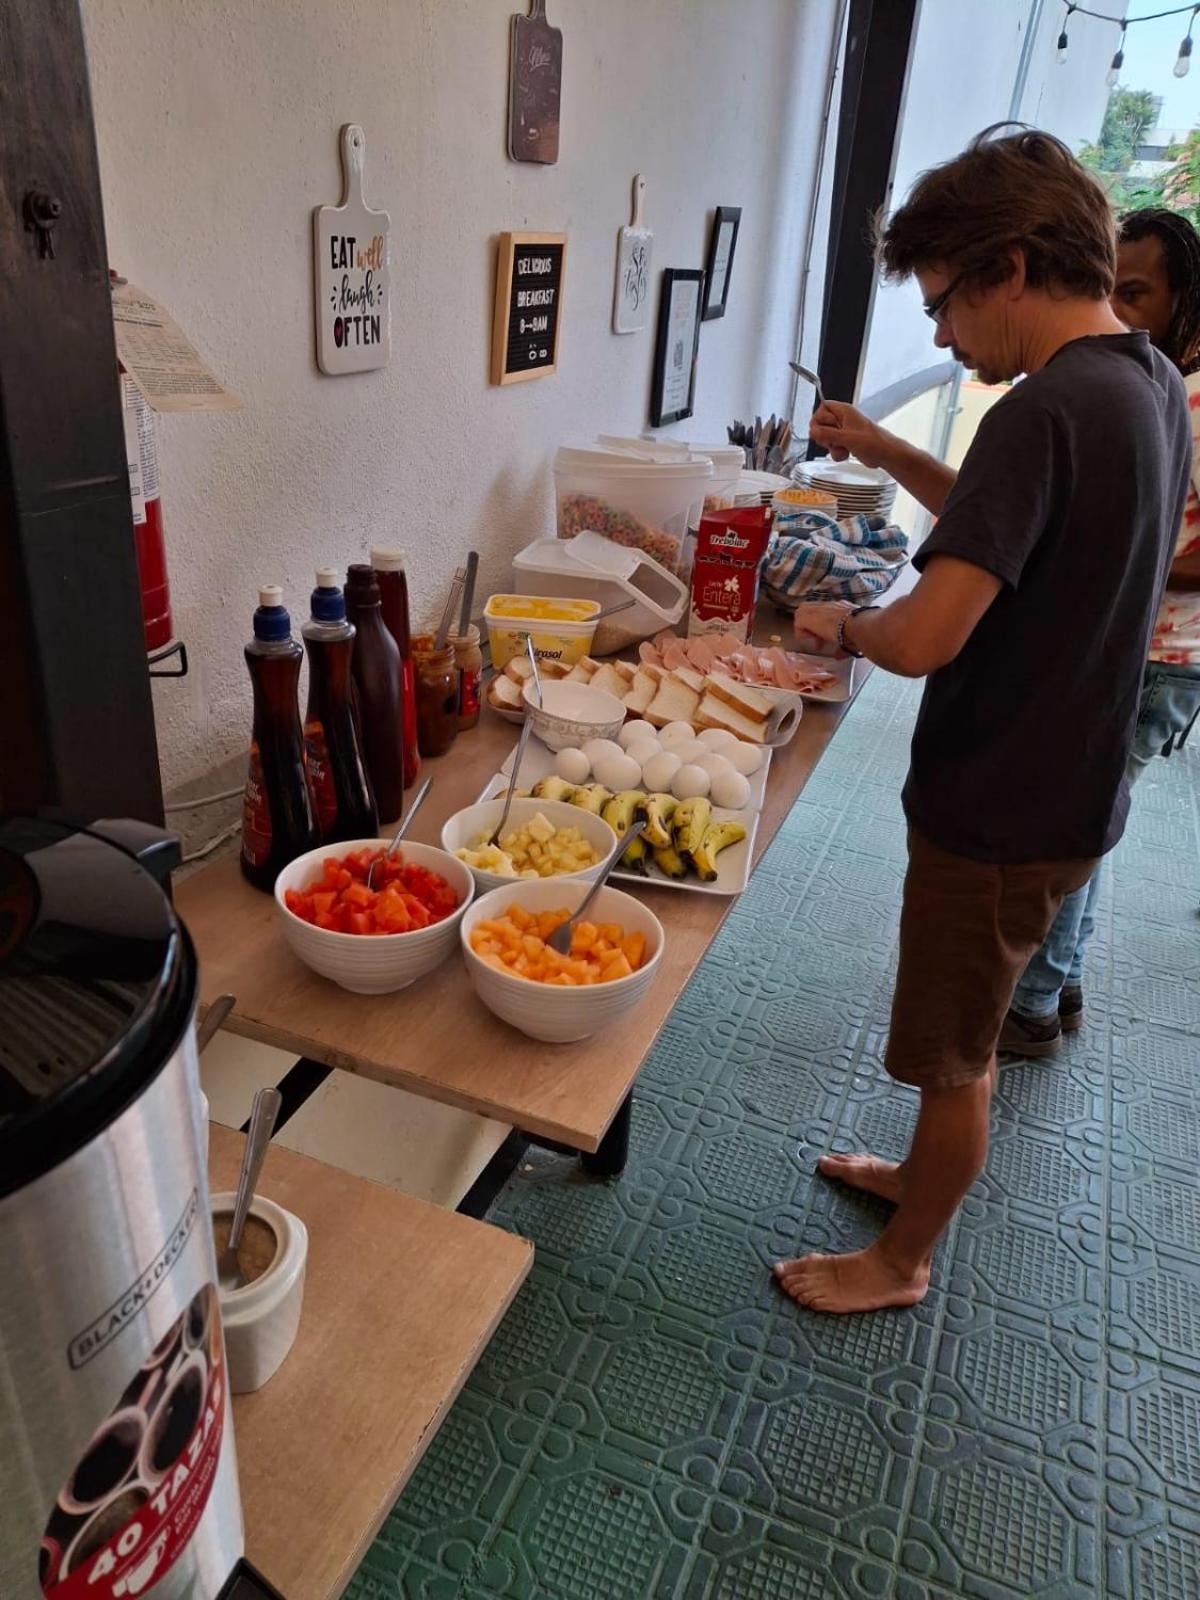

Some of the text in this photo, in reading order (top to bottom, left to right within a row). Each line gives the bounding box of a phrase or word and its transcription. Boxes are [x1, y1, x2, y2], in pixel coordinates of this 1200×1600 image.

[330, 235, 384, 271] EAT well
[517, 257, 552, 275] DELICIOUS
[338, 269, 375, 314] laugh
[517, 289, 555, 307] BREAKFAST
[333, 315, 380, 348] OFTEN
[703, 586, 741, 605] Entera
[87, 1521, 142, 1585] 40
